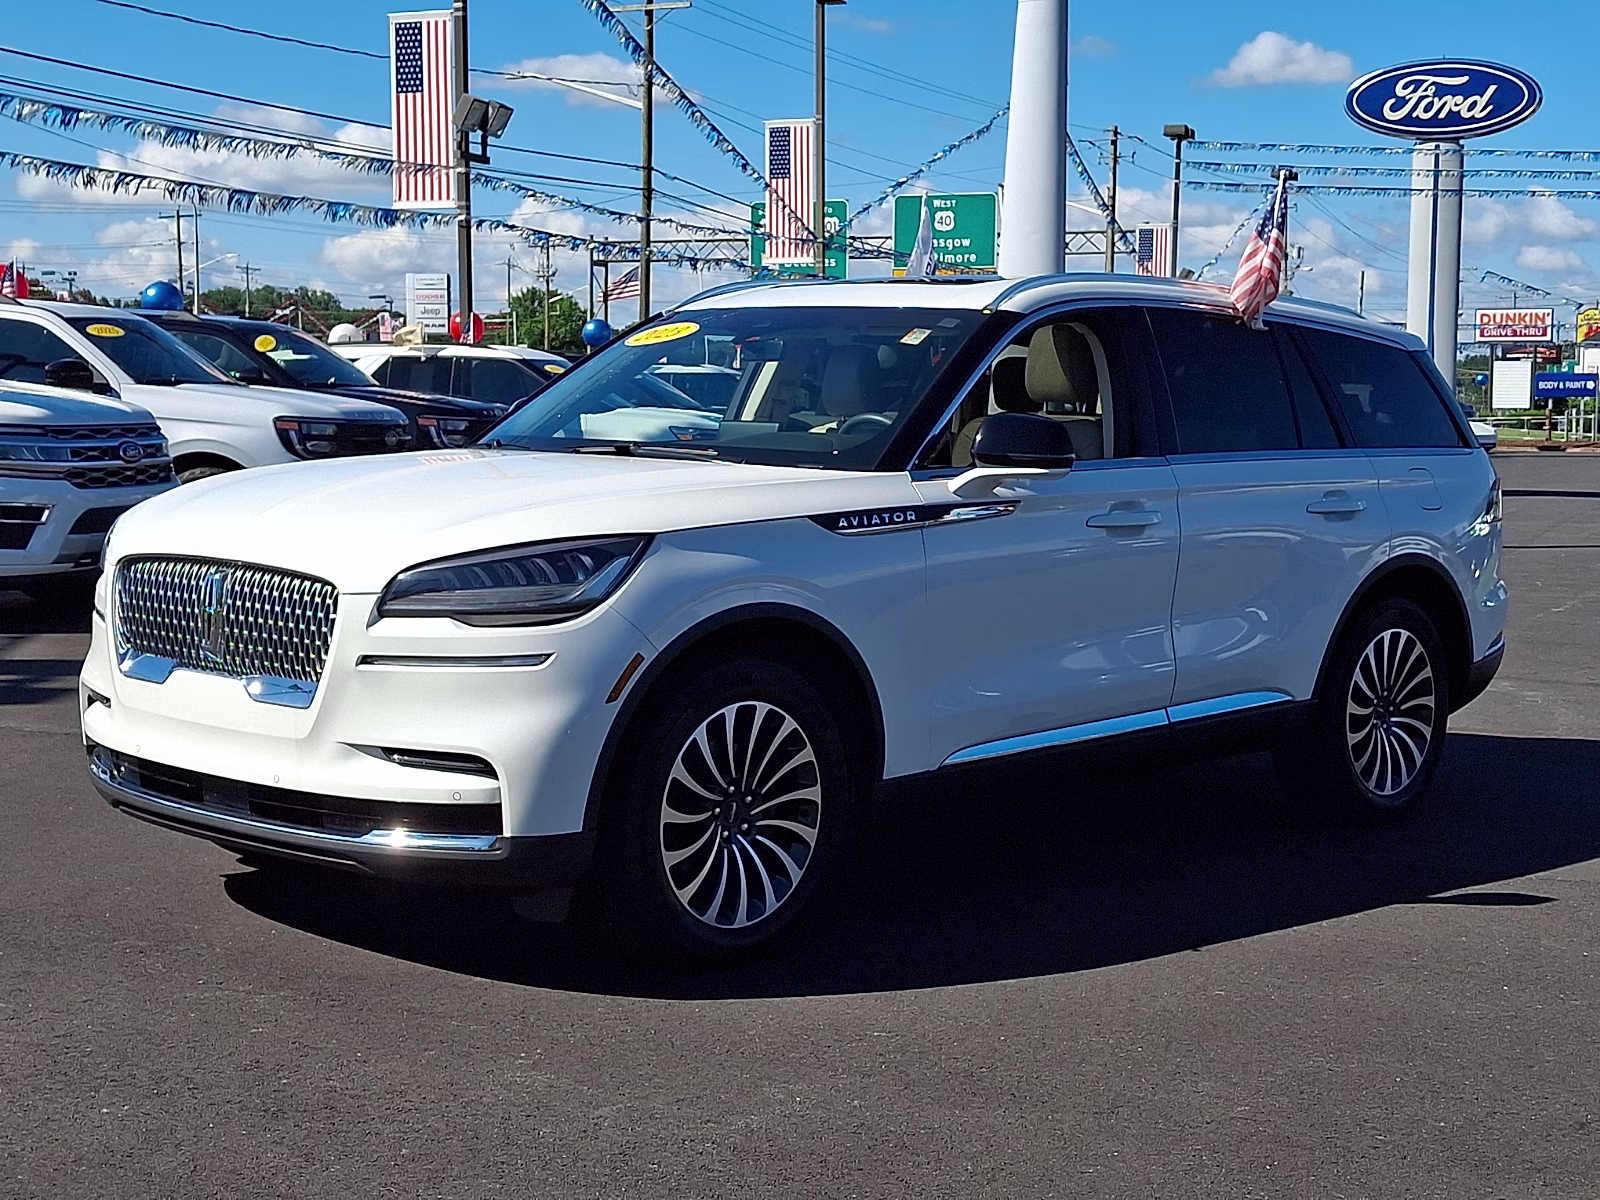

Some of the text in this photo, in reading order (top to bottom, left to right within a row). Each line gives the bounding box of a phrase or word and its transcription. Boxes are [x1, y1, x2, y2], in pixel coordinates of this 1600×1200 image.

[1382, 75, 1499, 121] Ford
[932, 199, 957, 208] WEST
[936, 215, 952, 227] 40
[932, 238, 971, 251] asgow
[935, 252, 977, 263] timore
[420, 306, 441, 316] Jeep
[1479, 312, 1551, 326] DUNKIN'
[1483, 327, 1543, 337] DRIVE THRU
[1538, 381, 1558, 390] BODY
[1565, 381, 1586, 390] PAINT
[838, 511, 917, 528] AVIATOR
